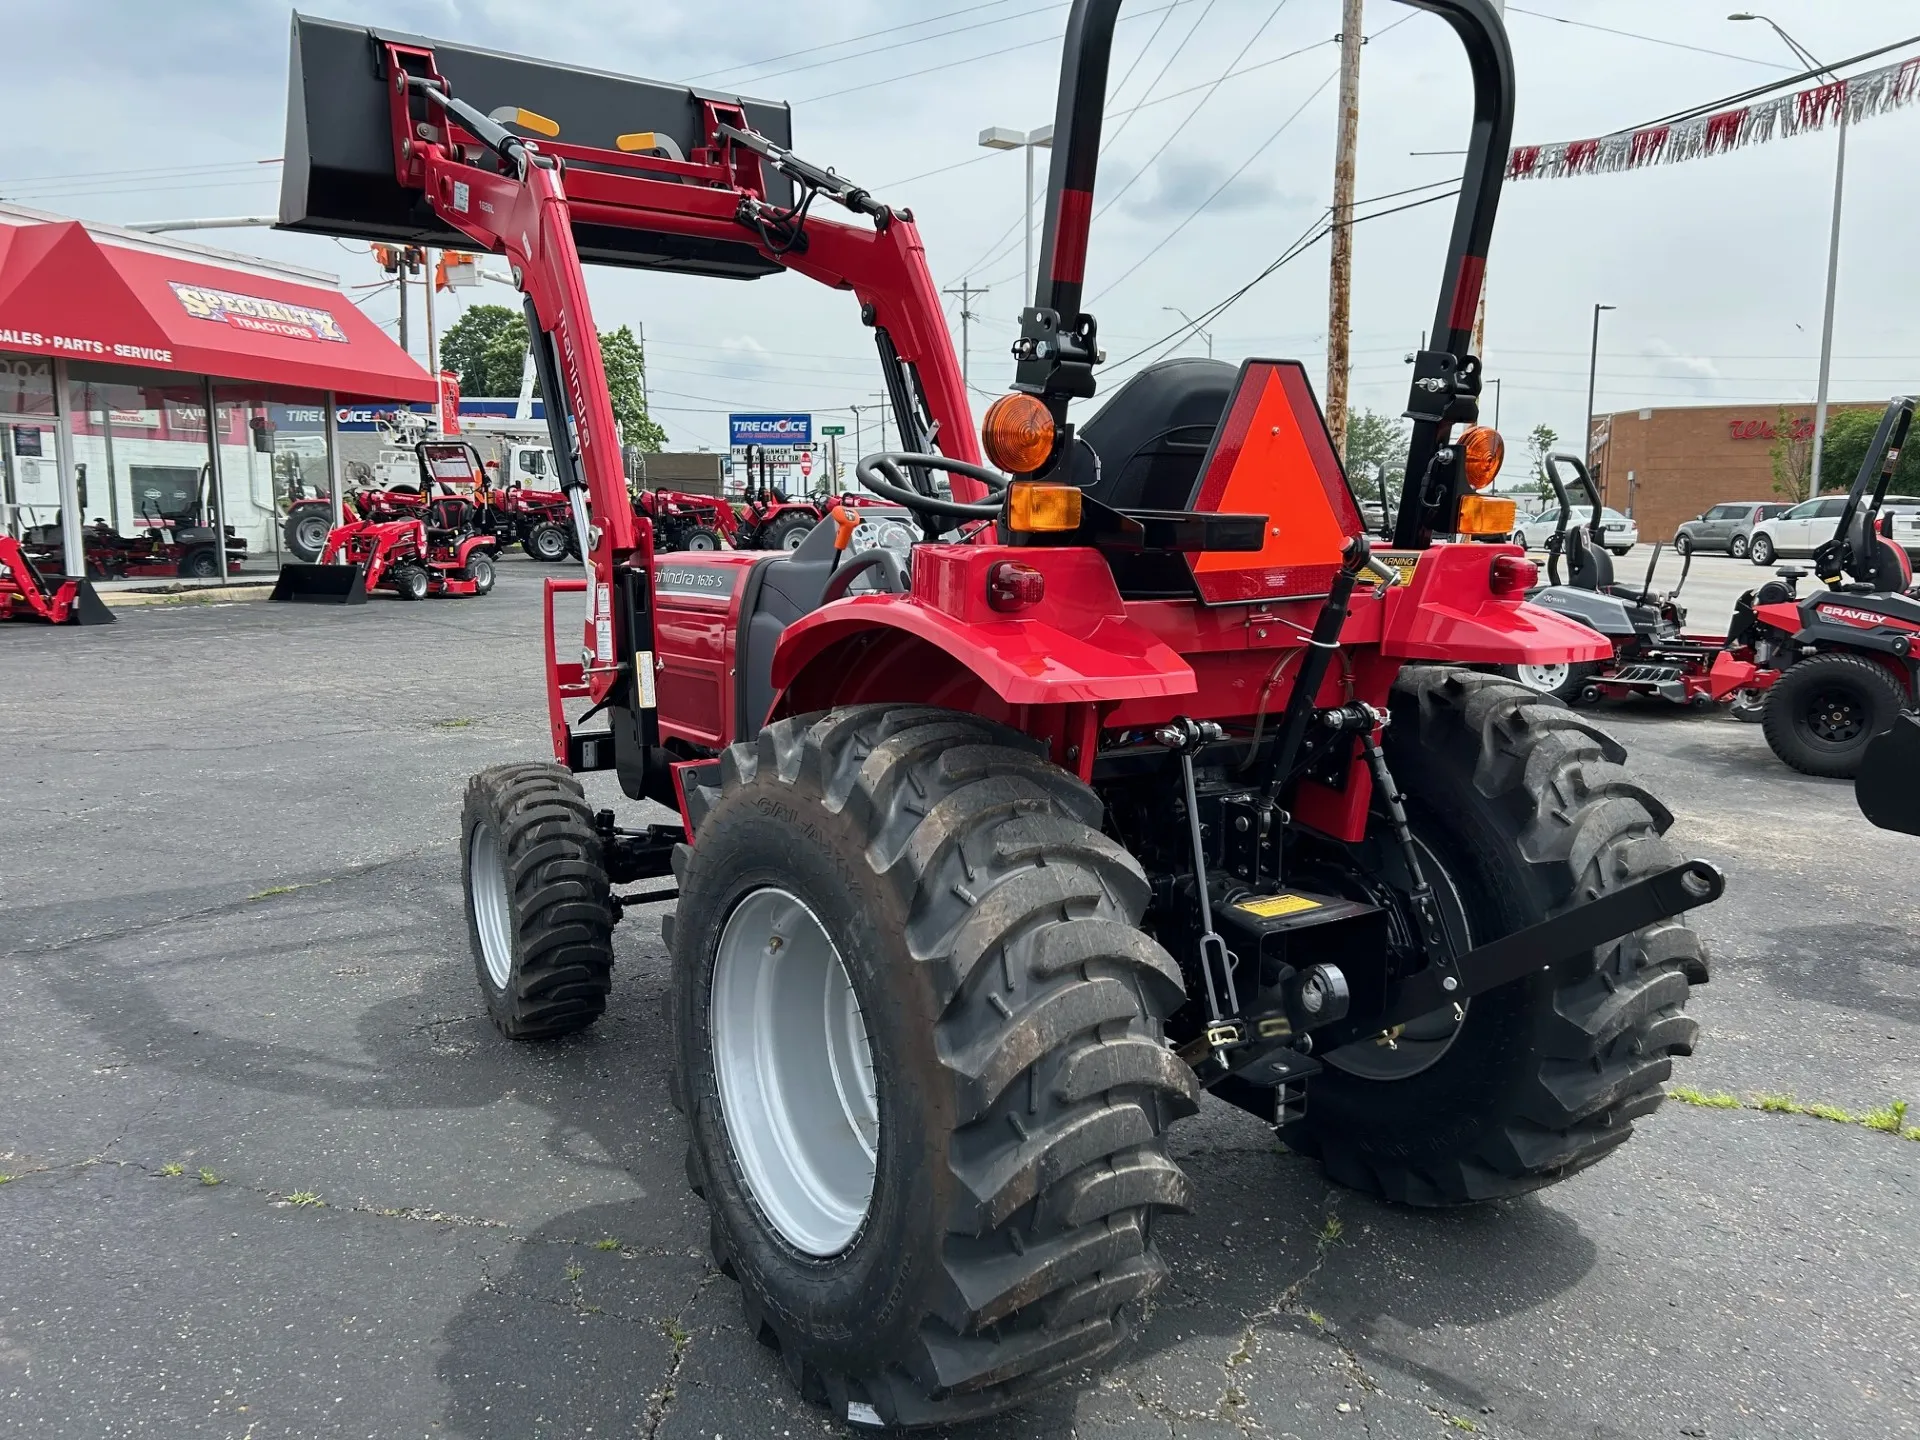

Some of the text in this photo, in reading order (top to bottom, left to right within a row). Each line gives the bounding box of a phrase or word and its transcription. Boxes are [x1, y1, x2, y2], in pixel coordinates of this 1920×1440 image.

[176, 287, 341, 337] SPECIALTY
[231, 316, 313, 339] TRACTORS
[53, 335, 104, 354] PARTS
[113, 343, 173, 363] SERVICE
[559, 308, 590, 448] mahindra
[110, 414, 145, 422] GRAVELY
[286, 410, 319, 422] TIRE
[319, 408, 372, 423] COICE
[732, 419, 808, 432] TIRE CHOICE
[654, 568, 723, 587] ahindra 1626 S
[1822, 605, 1887, 624] GRAVELY
